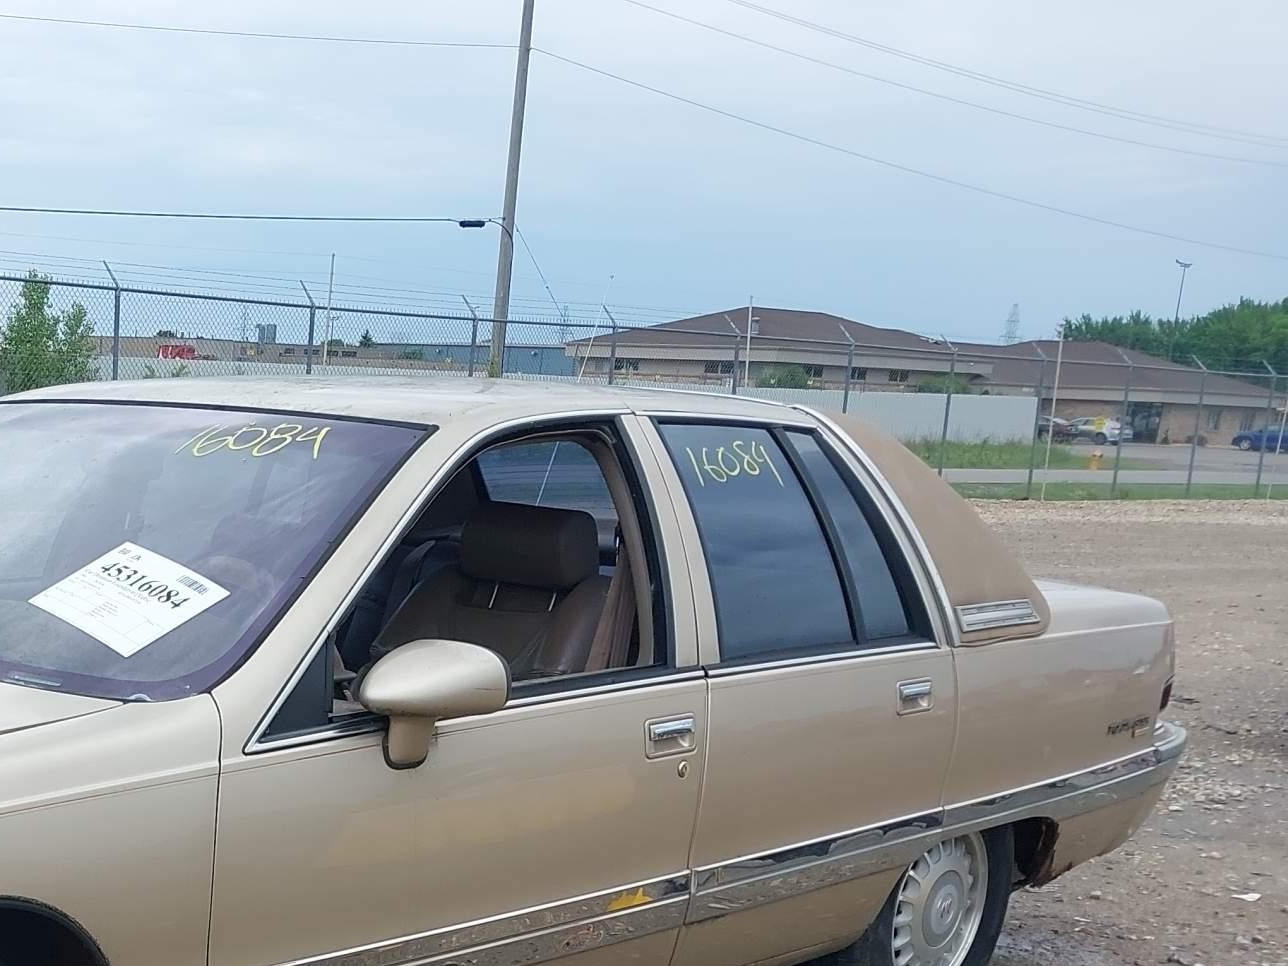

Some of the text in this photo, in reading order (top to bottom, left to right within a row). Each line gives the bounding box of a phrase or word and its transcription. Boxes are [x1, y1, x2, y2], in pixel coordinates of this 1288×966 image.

[174, 423, 332, 460] 16084
[686, 440, 784, 488] 16084
[100, 561, 191, 610] 45316084
